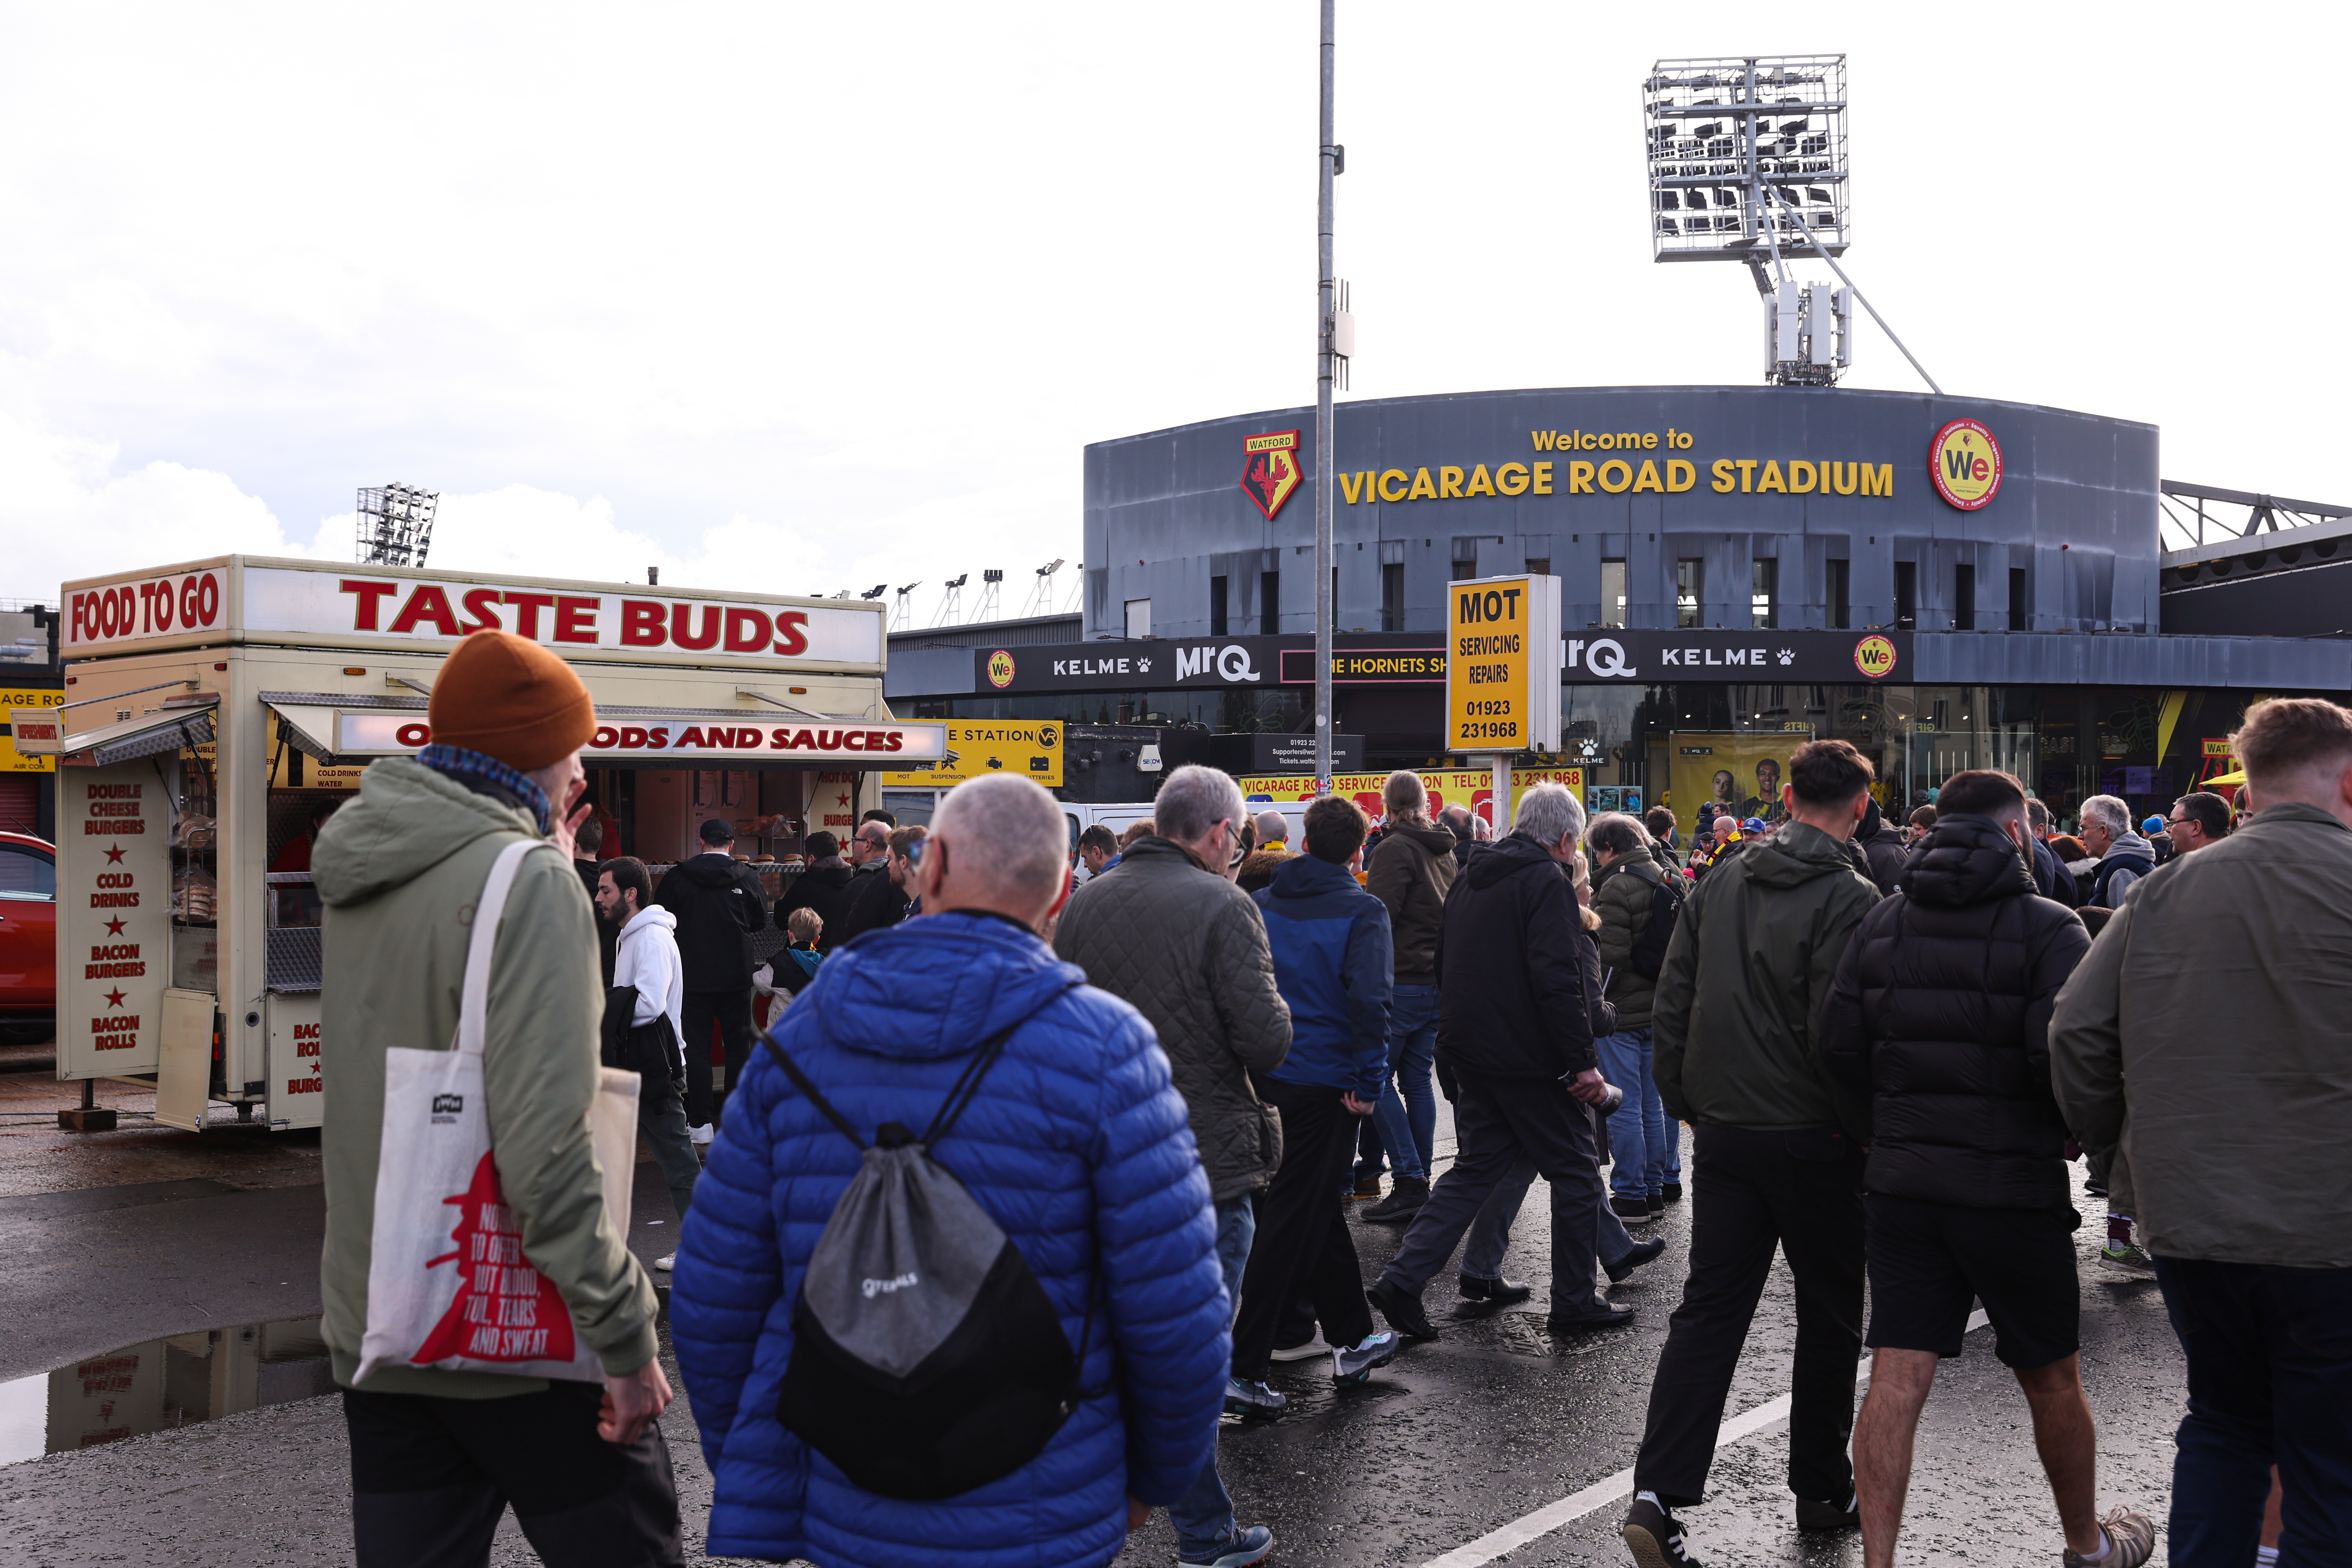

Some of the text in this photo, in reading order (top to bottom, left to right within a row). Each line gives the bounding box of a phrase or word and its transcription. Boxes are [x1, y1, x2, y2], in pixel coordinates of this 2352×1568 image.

[1250, 437, 1290, 449] WATFORD
[1531, 428, 1693, 451] Welcome to
[1934, 423, 2000, 506] Respect Inclusion Equality Together Diversity Family Empowerment
[1946, 450, 1989, 481] We
[1339, 459, 1893, 504] VICARAGE ROAD STADIUM
[71, 573, 219, 642] FOOD TO GO
[1460, 588, 1521, 624] MOT
[339, 579, 808, 656] TASTE BUDS
[1460, 634, 1520, 656] SERVICING
[1176, 645, 1260, 682] MrQ
[1331, 657, 1447, 673] HE HORNETS SH
[1561, 638, 1637, 678] rQ
[1662, 648, 1767, 666] KELME
[1862, 650, 1889, 664] We
[992, 663, 1010, 676] We
[1054, 658, 1130, 676] KELME
[1469, 664, 1508, 684] REPAIRS
[1, 694, 65, 705] AGE RO
[1467, 700, 1510, 716] 01923
[964, 730, 1034, 741] STATION
[1039, 731, 1056, 743] VR
[1461, 721, 1517, 738] 231968
[673, 726, 763, 749] AND
[770, 728, 903, 752] SAUCES
[821, 771, 841, 784] HOT
[1244, 779, 1300, 793] VICARAGE
[1339, 777, 1386, 791] SERVICE
[1453, 774, 1477, 788] TEL:
[1524, 772, 1550, 786] 231
[1554, 770, 1580, 785] 968
[87, 784, 142, 799] DOUBLE
[89, 802, 140, 817] CHEESE
[84, 819, 145, 835] BURGERS
[823, 813, 853, 827] BURGE
[96, 873, 134, 889] COLD
[90, 892, 140, 908] DRINKS
[91, 944, 140, 961] BACON
[85, 961, 146, 980] BURGERS
[91, 1015, 140, 1033] BACON
[293, 1023, 321, 1040] BAC
[95, 1033, 136, 1051] ROLLS
[297, 1041, 321, 1058] ROL
[287, 1078, 323, 1095] BURG
[470, 1233, 520, 1265] TO OFFER
[474, 1264, 541, 1298] BUT BLOOD,
[464, 1296, 536, 1327] TOIL, TEARS
[469, 1329, 549, 1356] AND SWEAT.
